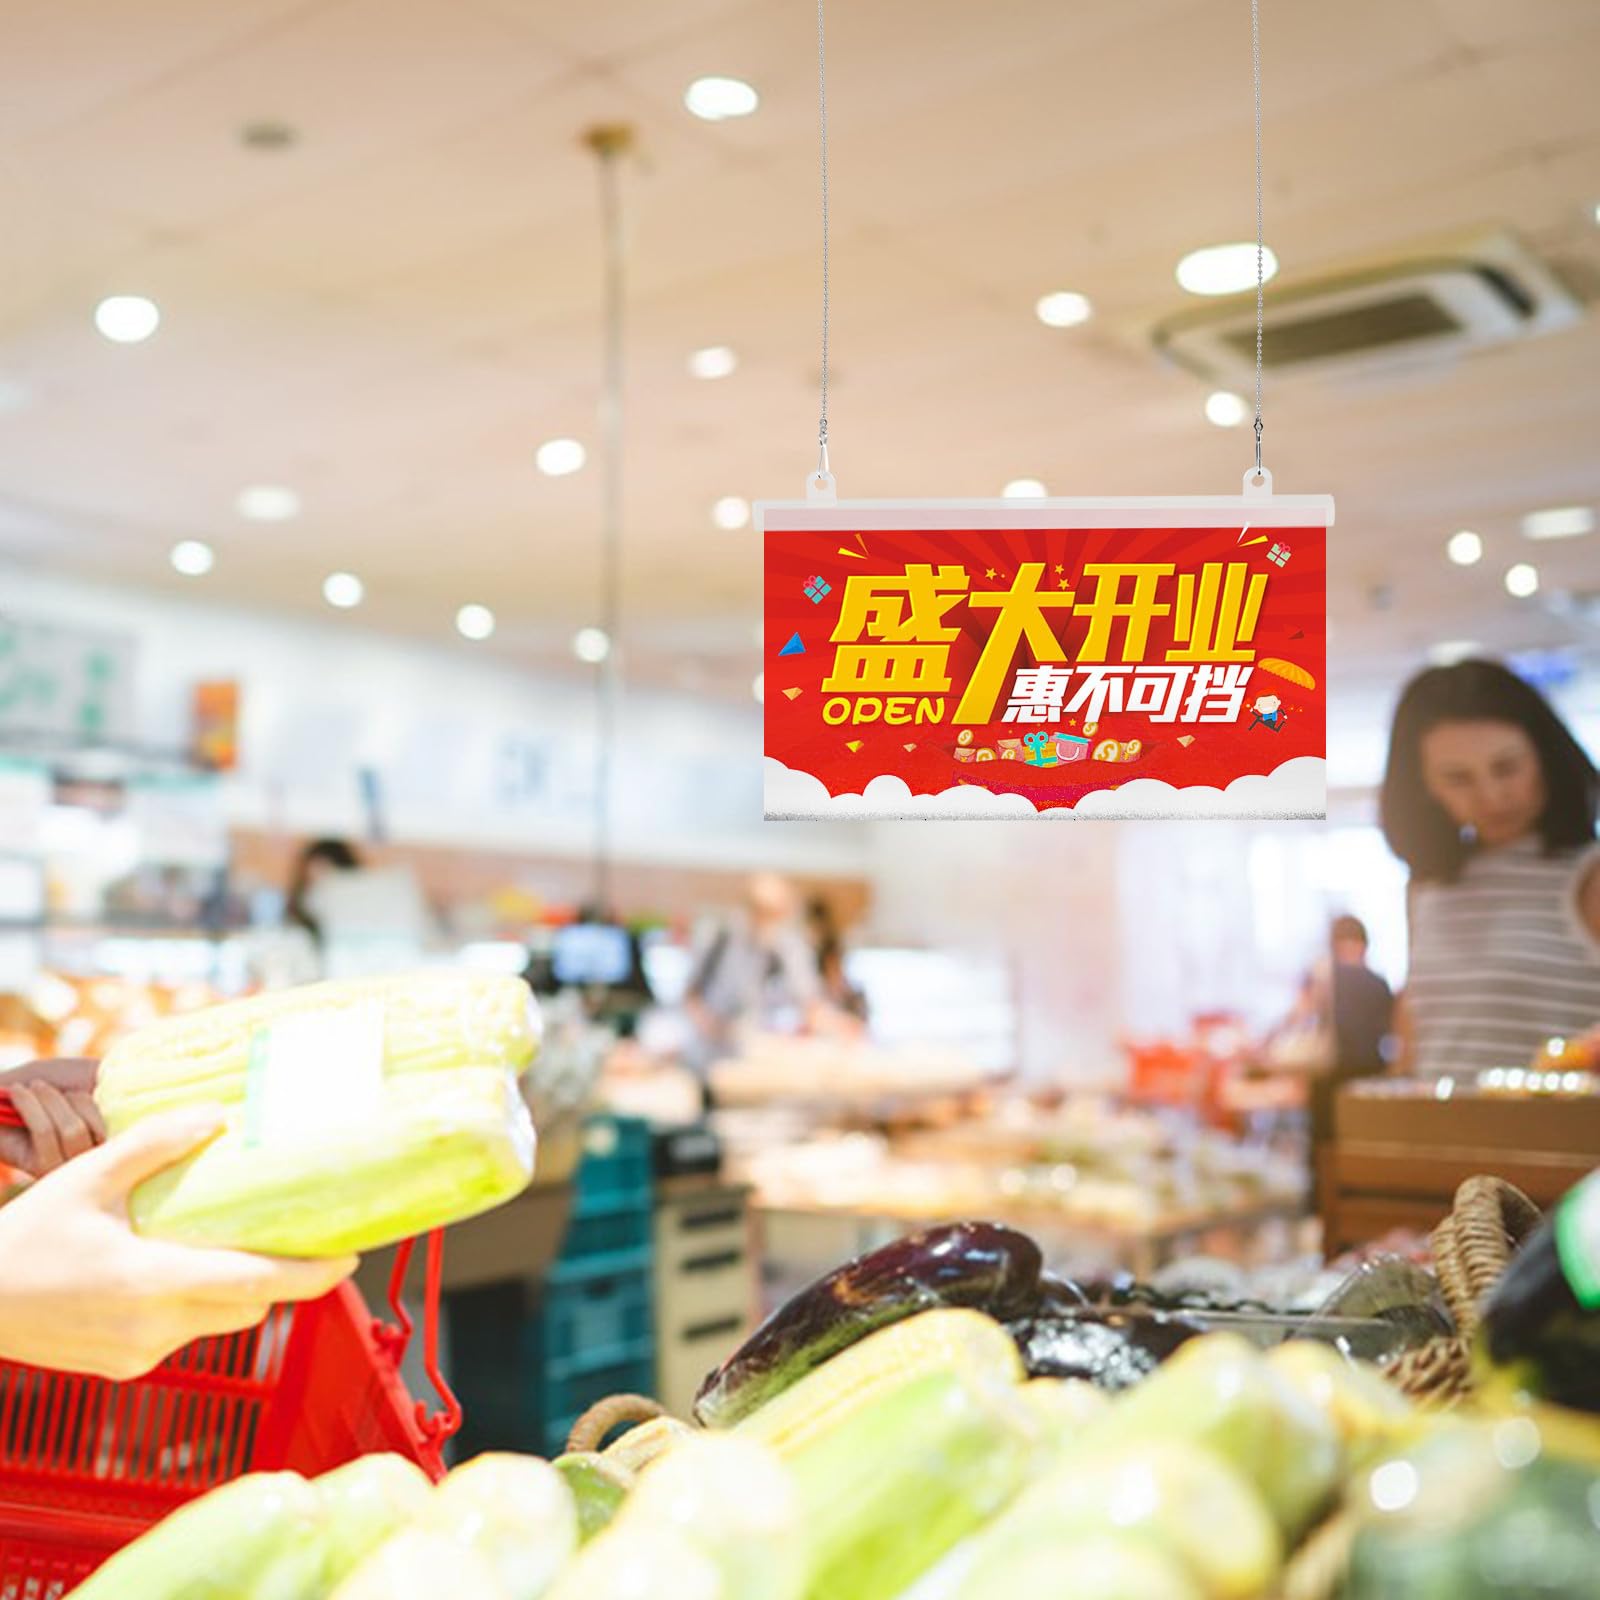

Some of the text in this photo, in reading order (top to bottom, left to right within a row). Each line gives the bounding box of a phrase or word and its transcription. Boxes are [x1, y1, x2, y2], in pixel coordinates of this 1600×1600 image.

[822, 562, 1269, 724] 盛大开业
[822, 697, 945, 725] OPEN
[1001, 666, 1253, 723] 惠不可挡
